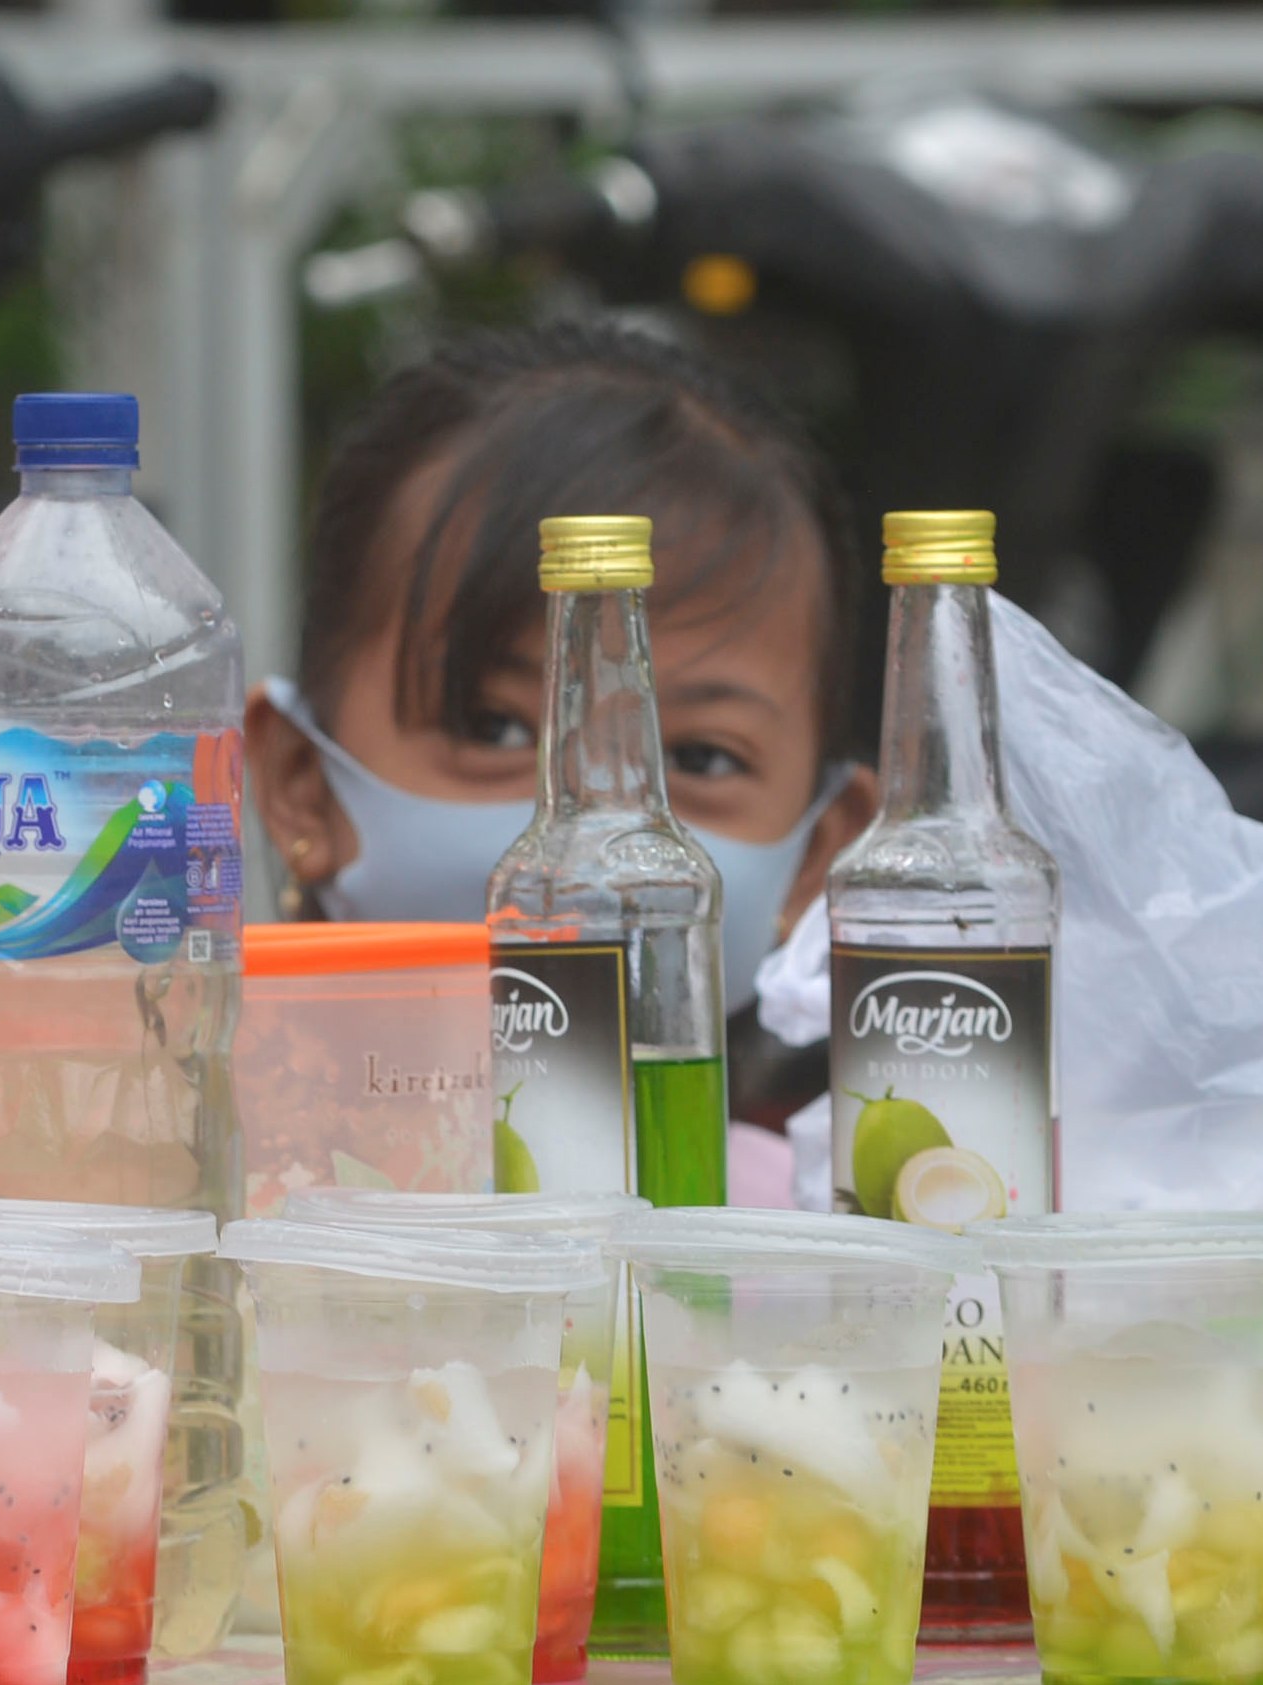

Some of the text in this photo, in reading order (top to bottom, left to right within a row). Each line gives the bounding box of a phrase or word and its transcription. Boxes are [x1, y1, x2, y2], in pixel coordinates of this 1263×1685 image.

[850, 970, 1012, 1056] Marjan
[868, 1061, 991, 1079] BOUDOIN
[961, 1378, 999, 1394] 460
